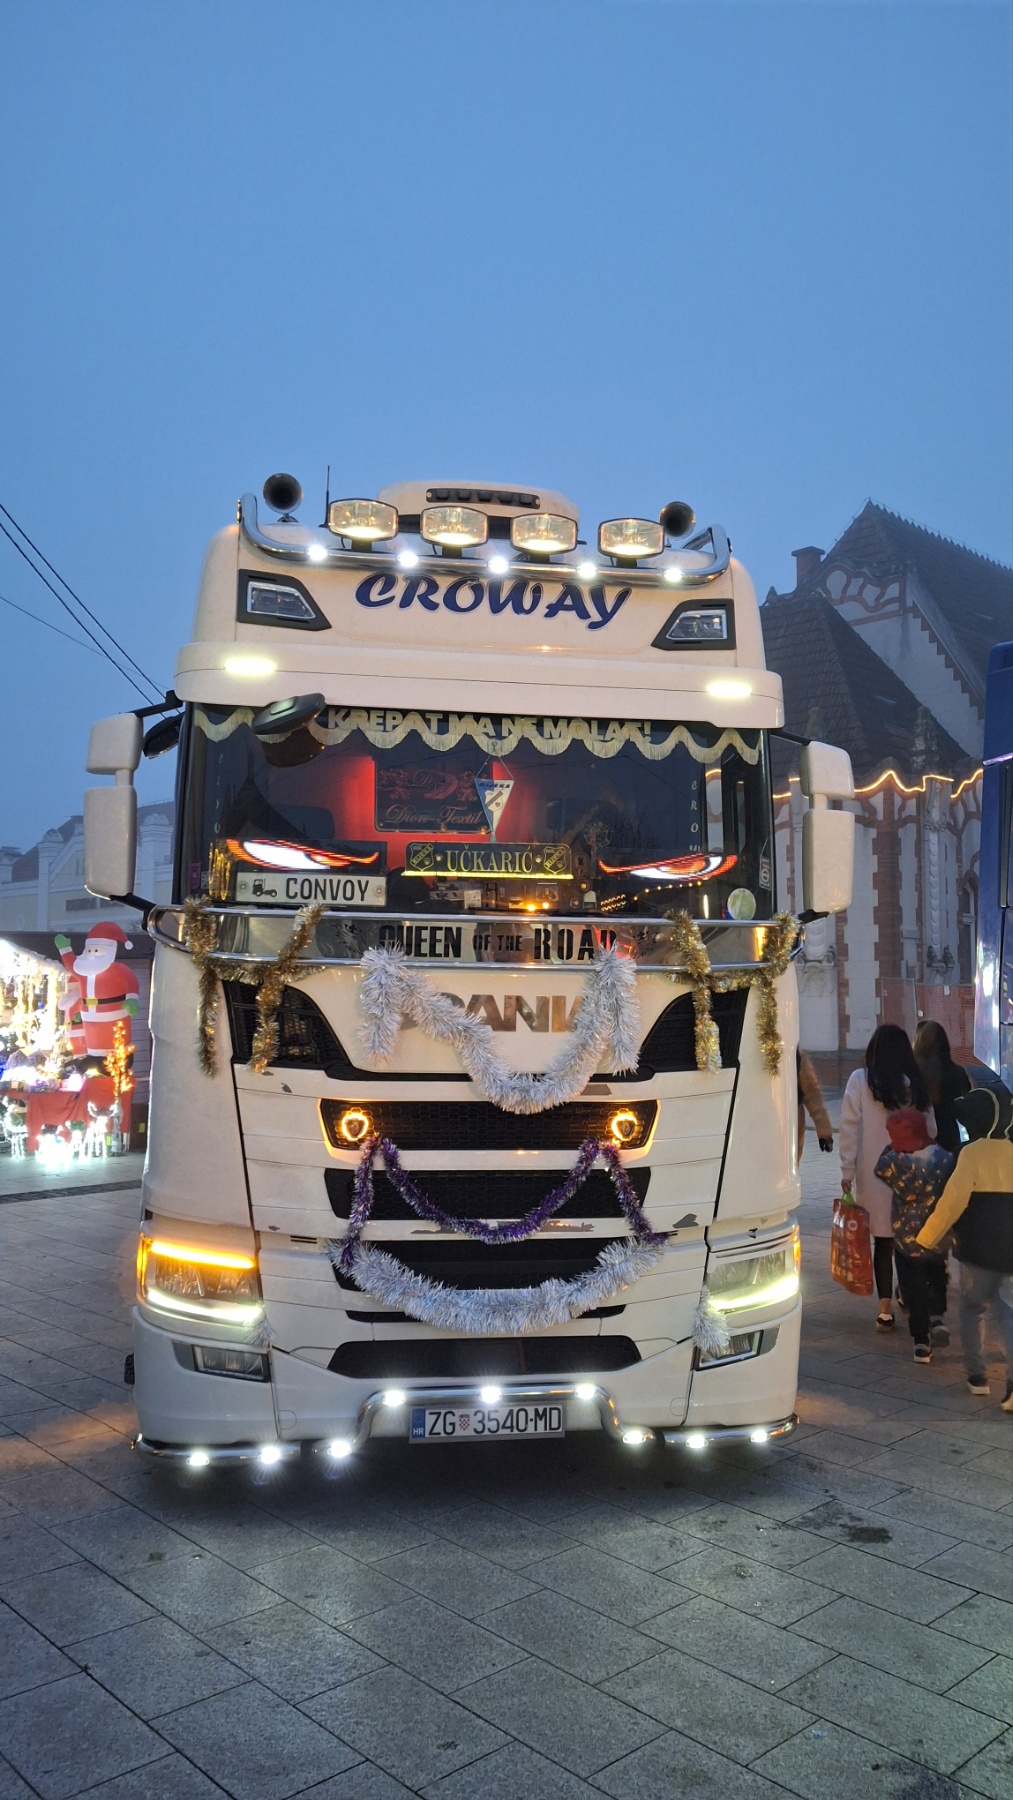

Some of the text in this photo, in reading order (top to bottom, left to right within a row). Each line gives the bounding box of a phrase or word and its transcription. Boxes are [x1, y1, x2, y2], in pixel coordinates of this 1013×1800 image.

[355, 571, 632, 631] CROWAY
[328, 708, 444, 734] KREPAT
[449, 714, 496, 737] MA
[502, 716, 537, 739] NE
[446, 844, 533, 873] UČKARIĆ
[286, 877, 369, 901] CONVOY
[379, 925, 462, 958] QUEEN
[473, 934, 491, 951] OF
[497, 934, 522, 951] THE
[428, 1410, 456, 1436] ZG
